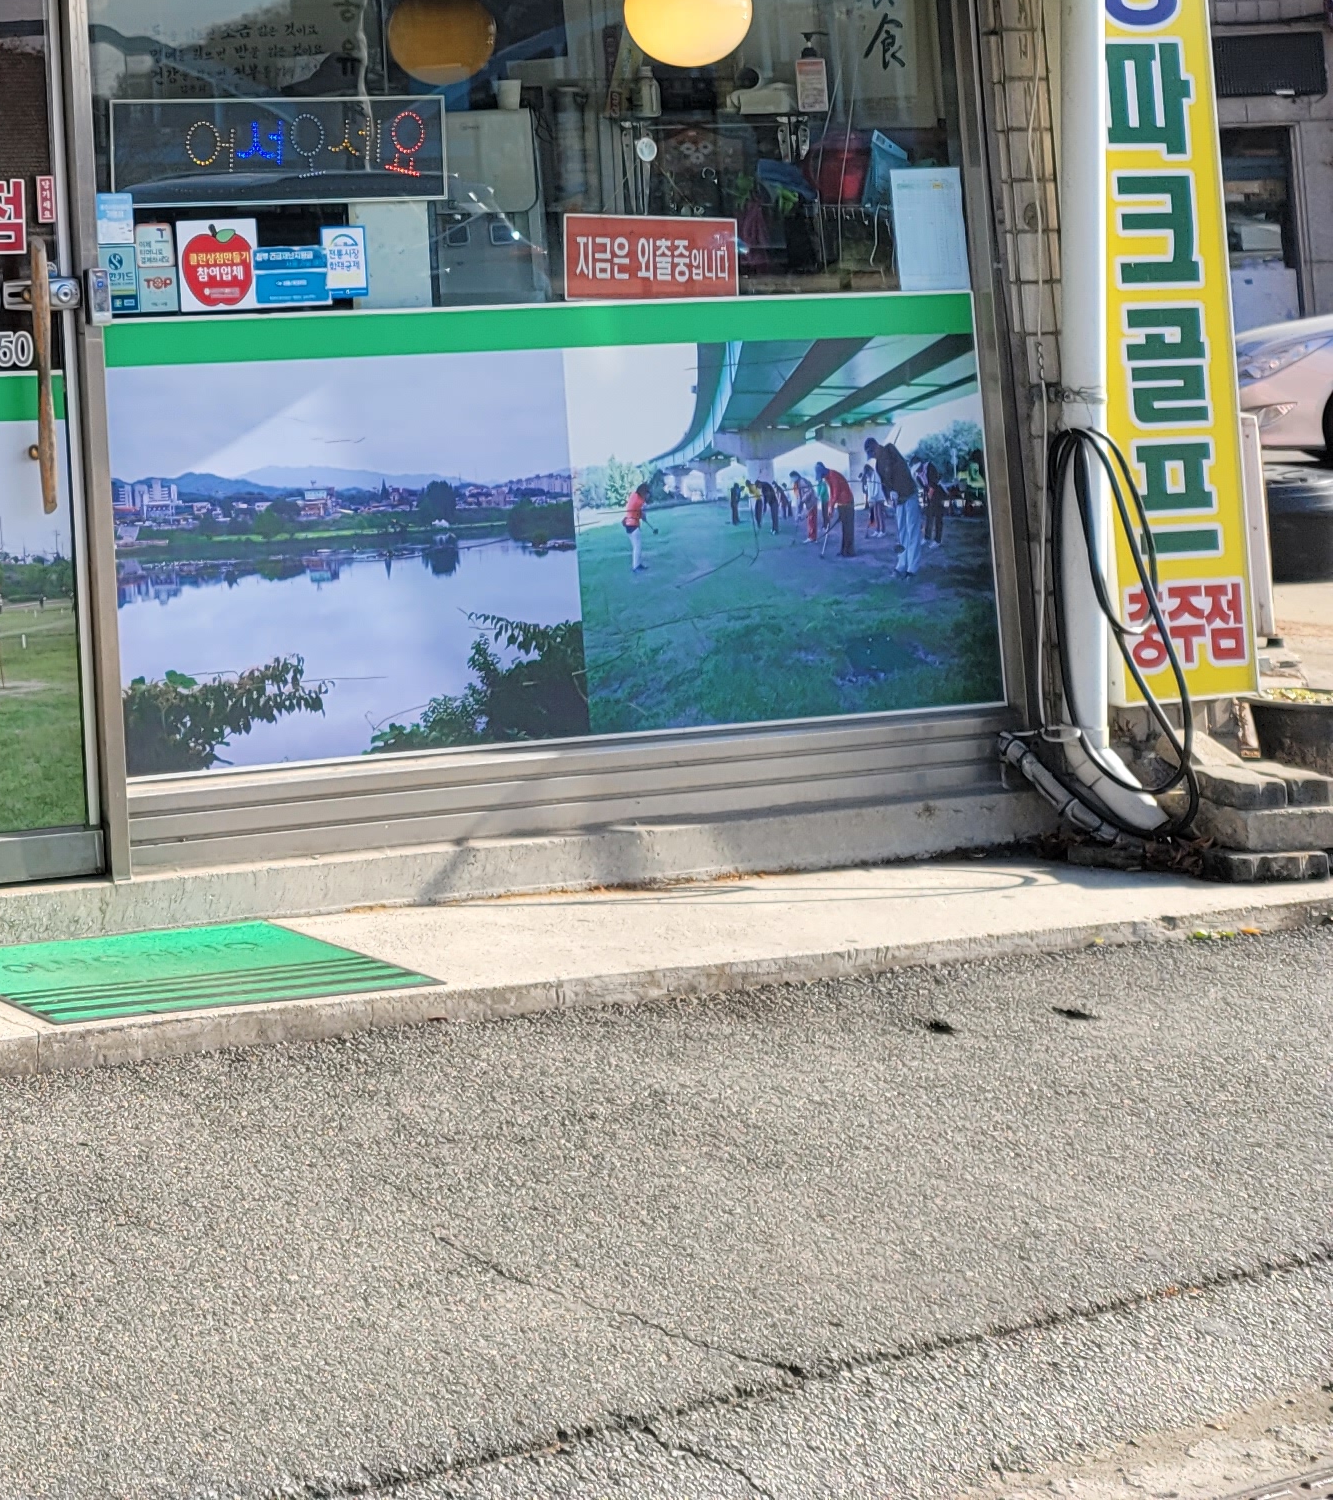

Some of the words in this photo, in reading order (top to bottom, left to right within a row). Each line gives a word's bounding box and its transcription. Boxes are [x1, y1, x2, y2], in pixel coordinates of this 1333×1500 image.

[185, 109, 426, 179] 어서오세요
[189, 250, 250, 266] 클린상점만들기
[196, 265, 244, 283] 참여업체
[576, 236, 630, 280] 지금은
[637, 237, 729, 283] 외출중입니다
